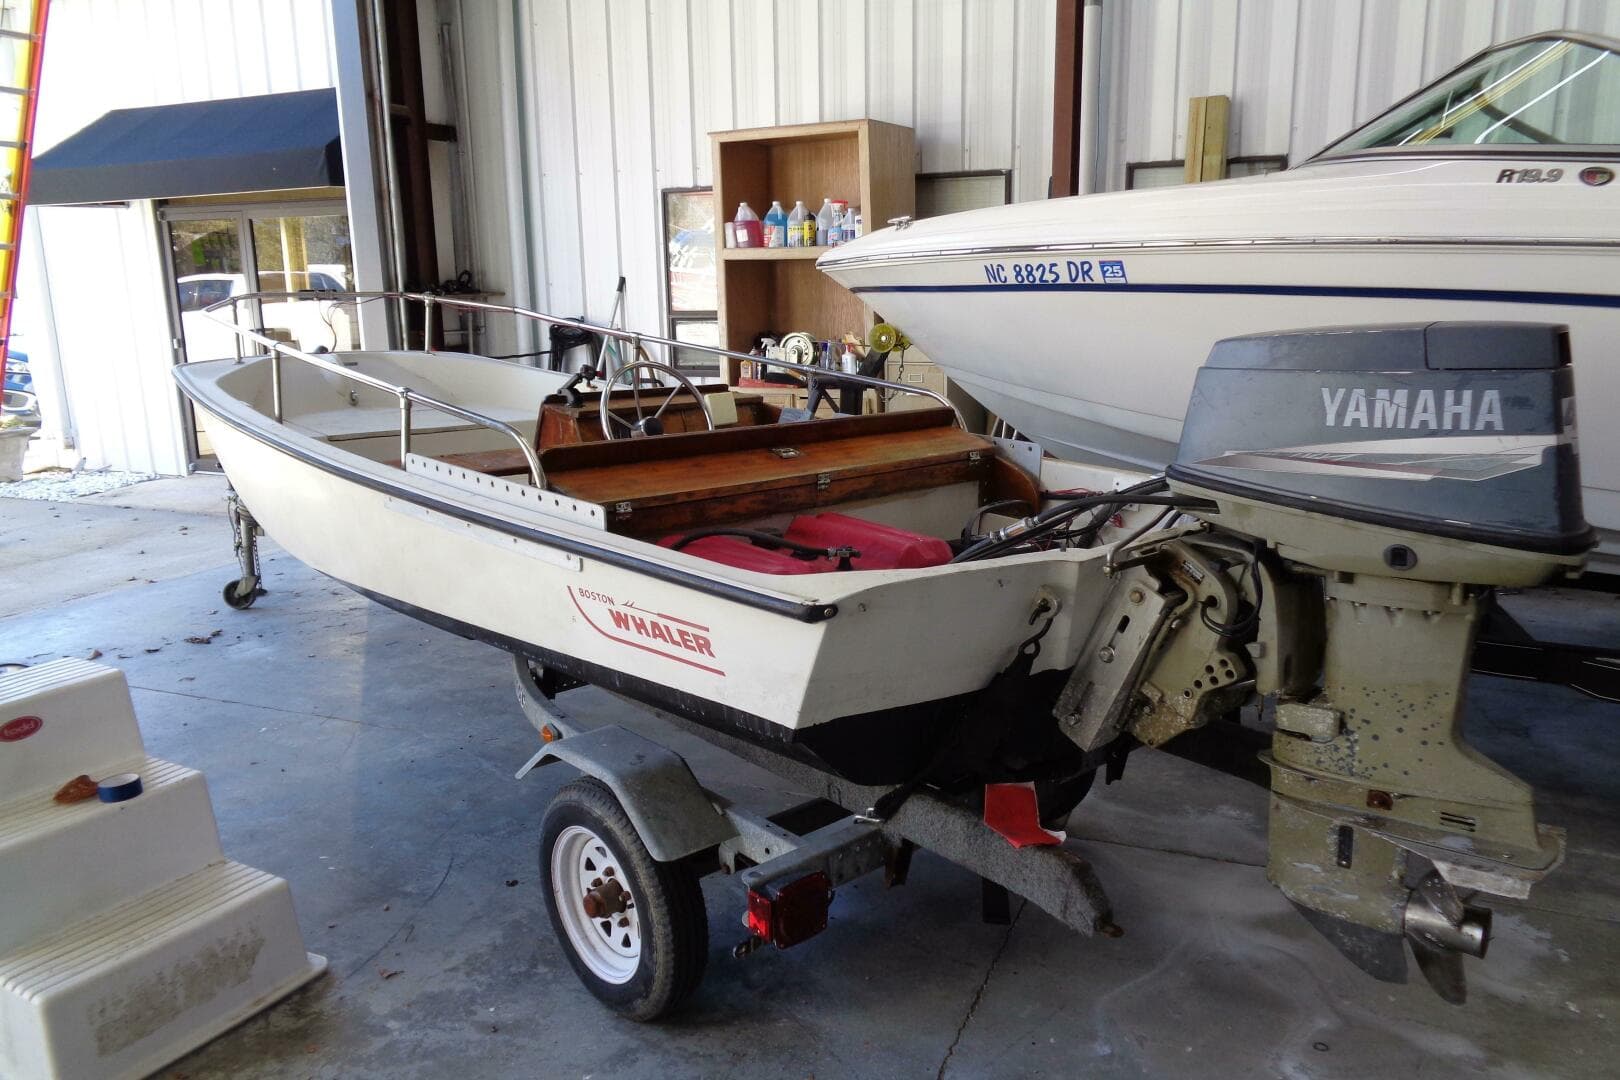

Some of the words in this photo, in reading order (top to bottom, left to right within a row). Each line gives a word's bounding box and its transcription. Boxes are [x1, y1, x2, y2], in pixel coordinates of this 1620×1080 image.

[1496, 168, 1564, 183] R19.9
[984, 264, 1007, 283] NC
[1013, 263, 1060, 283] 8825
[1066, 260, 1094, 283] DR
[1103, 265, 1123, 277] 25
[1320, 387, 1504, 431] YAMAHA
[578, 587, 615, 606] BOSTON
[608, 608, 716, 658] WHALER
